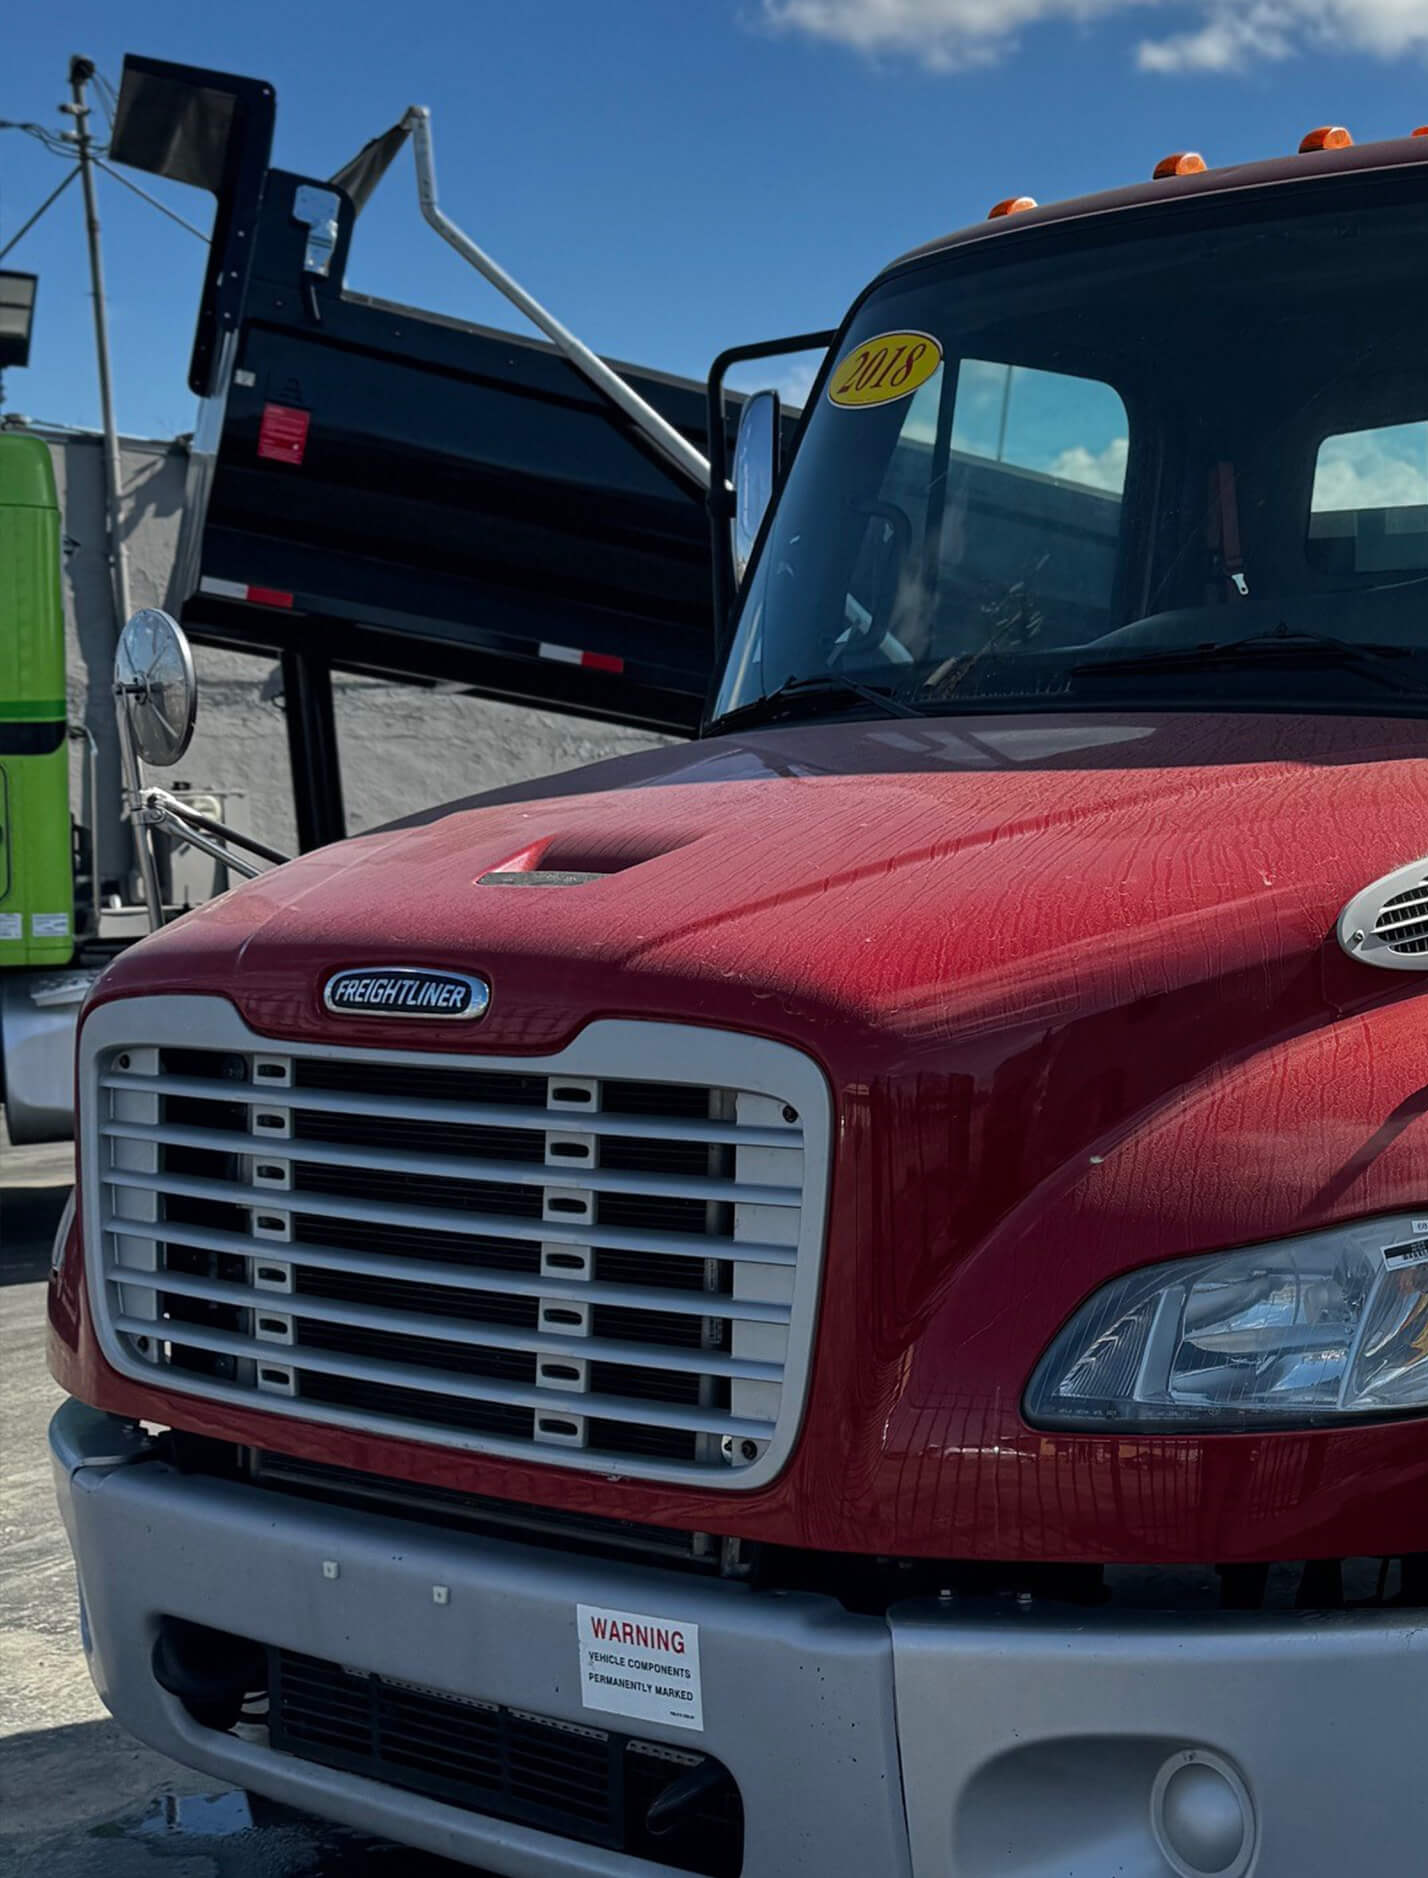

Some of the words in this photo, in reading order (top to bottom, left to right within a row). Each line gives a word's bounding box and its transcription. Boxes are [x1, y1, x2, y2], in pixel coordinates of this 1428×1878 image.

[837, 343, 926, 394] 2018
[335, 979, 466, 1008] FREIGHTLINER
[591, 1616, 685, 1653] WARNING
[588, 1651, 625, 1666] VEHICLE
[627, 1658, 691, 1679] COMPONENTS
[588, 1672, 652, 1694] PERMANENTLY
[655, 1685, 693, 1701] MARKED
